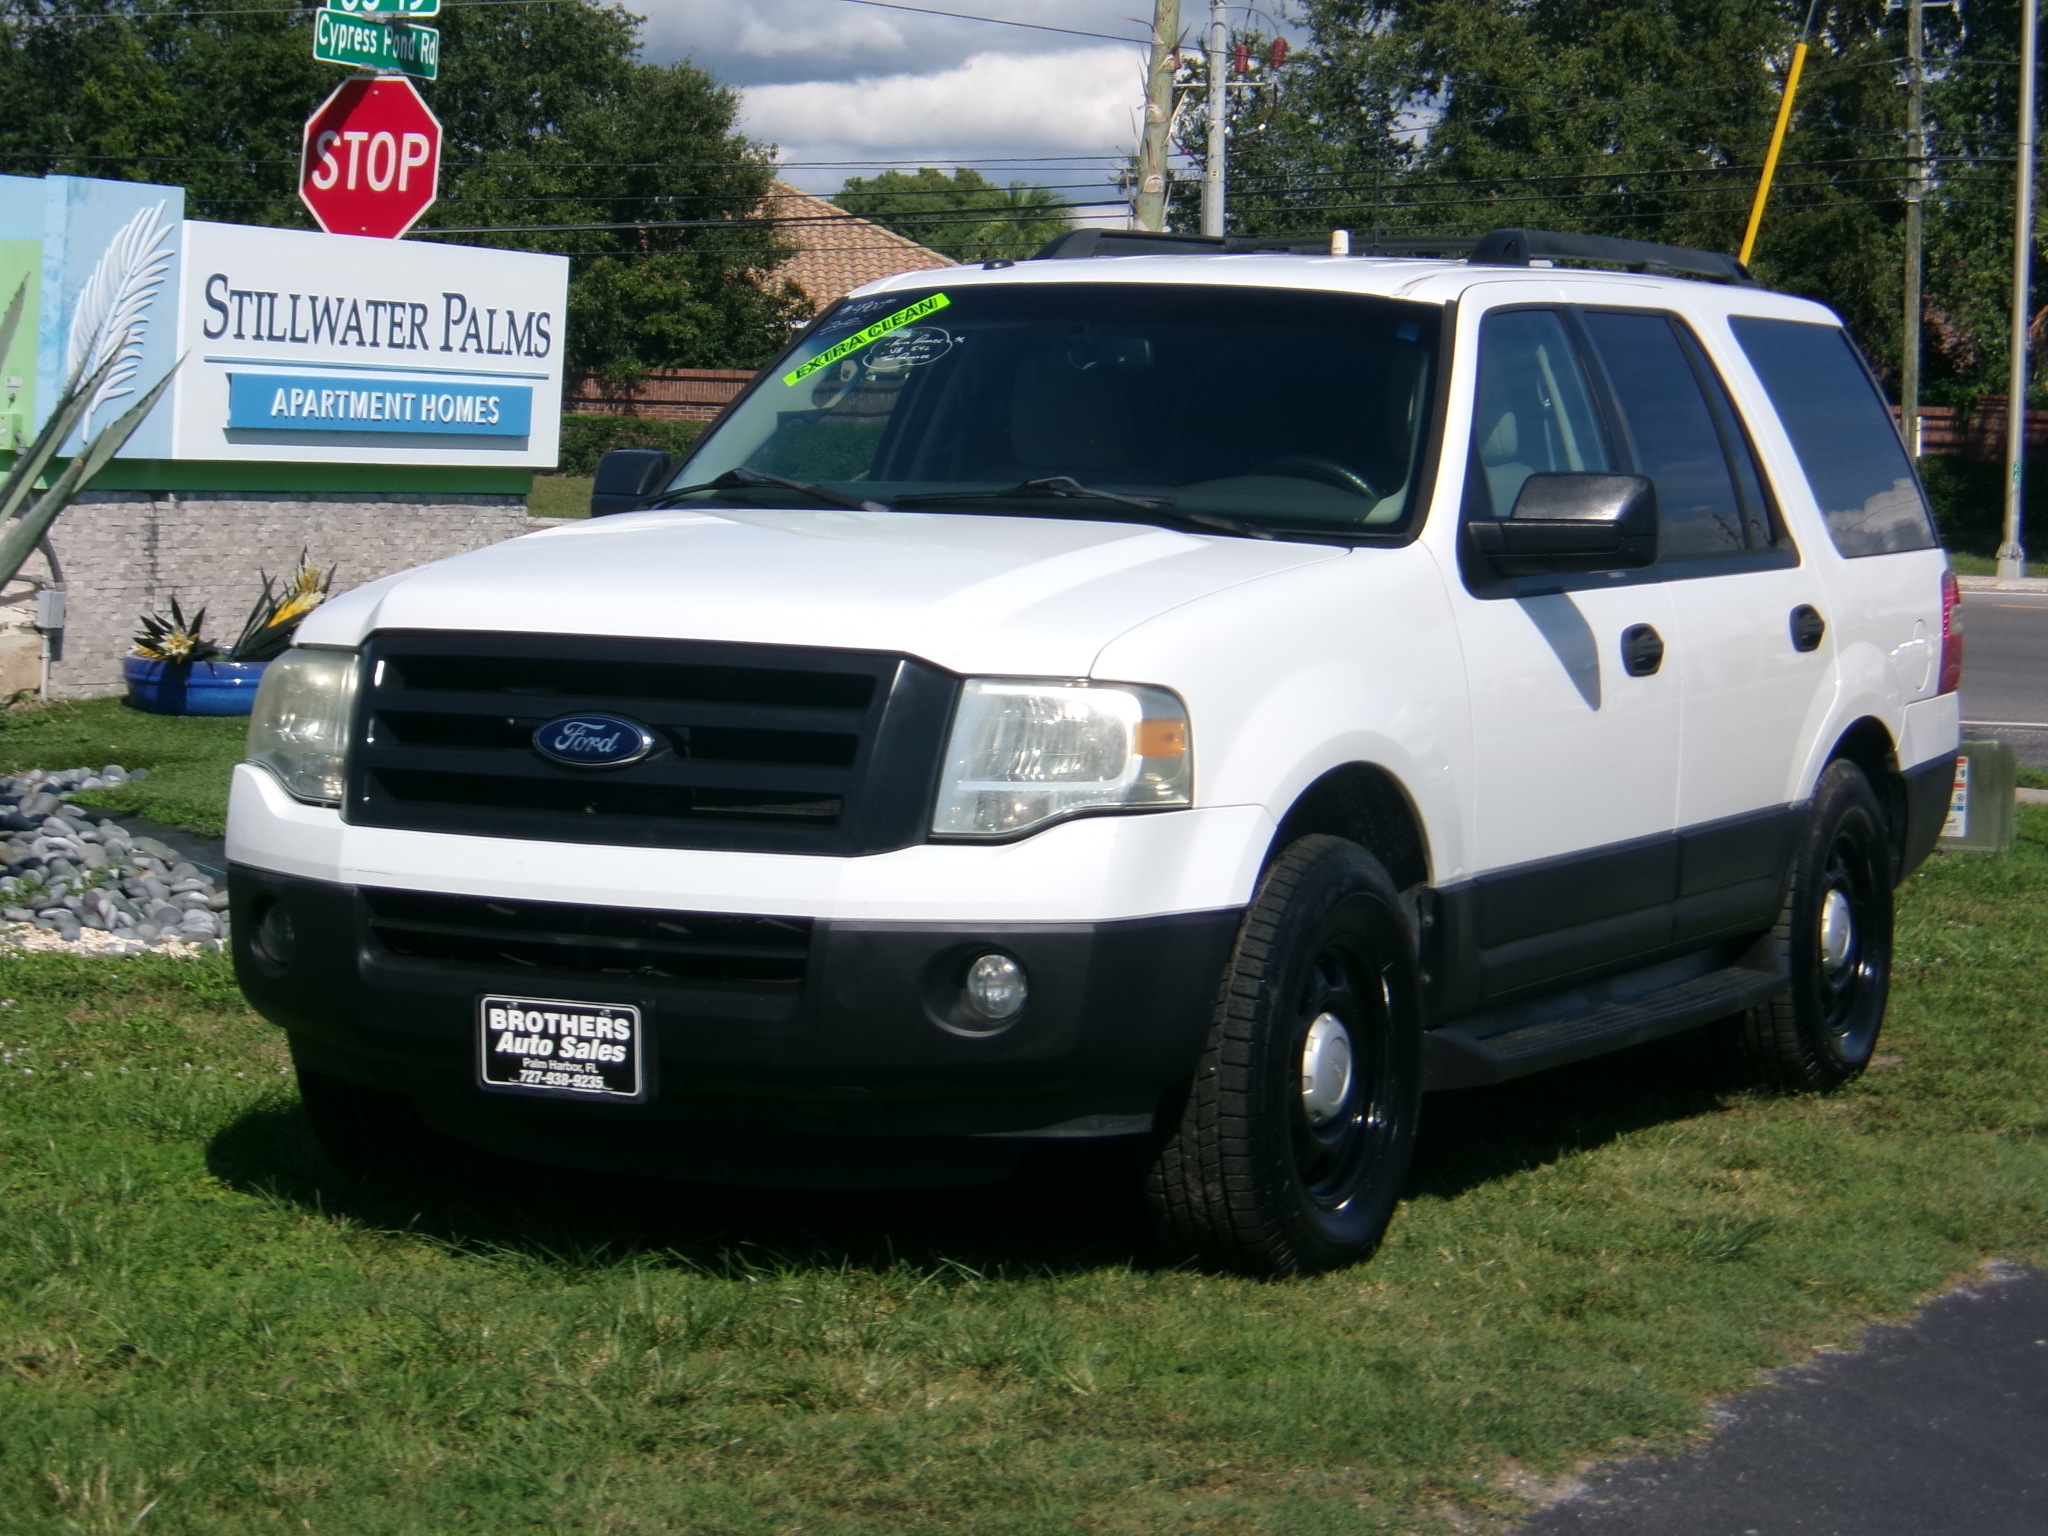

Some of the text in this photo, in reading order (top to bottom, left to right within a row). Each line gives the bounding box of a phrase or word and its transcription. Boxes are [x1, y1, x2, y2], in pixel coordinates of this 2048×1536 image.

[319, 13, 437, 66] Cypress Pond Rd
[312, 130, 430, 192] STOP
[203, 273, 552, 359] STILLWATER PALMS
[796, 335, 866, 380] EXTRA
[270, 387, 501, 425] APARTMENT HOMES
[554, 721, 621, 753] Ford
[489, 1008, 631, 1041] BROTHERS
[495, 1031, 627, 1063] Auto Sales
[522, 1057, 548, 1069] Palm
[585, 1062, 599, 1074] FL
